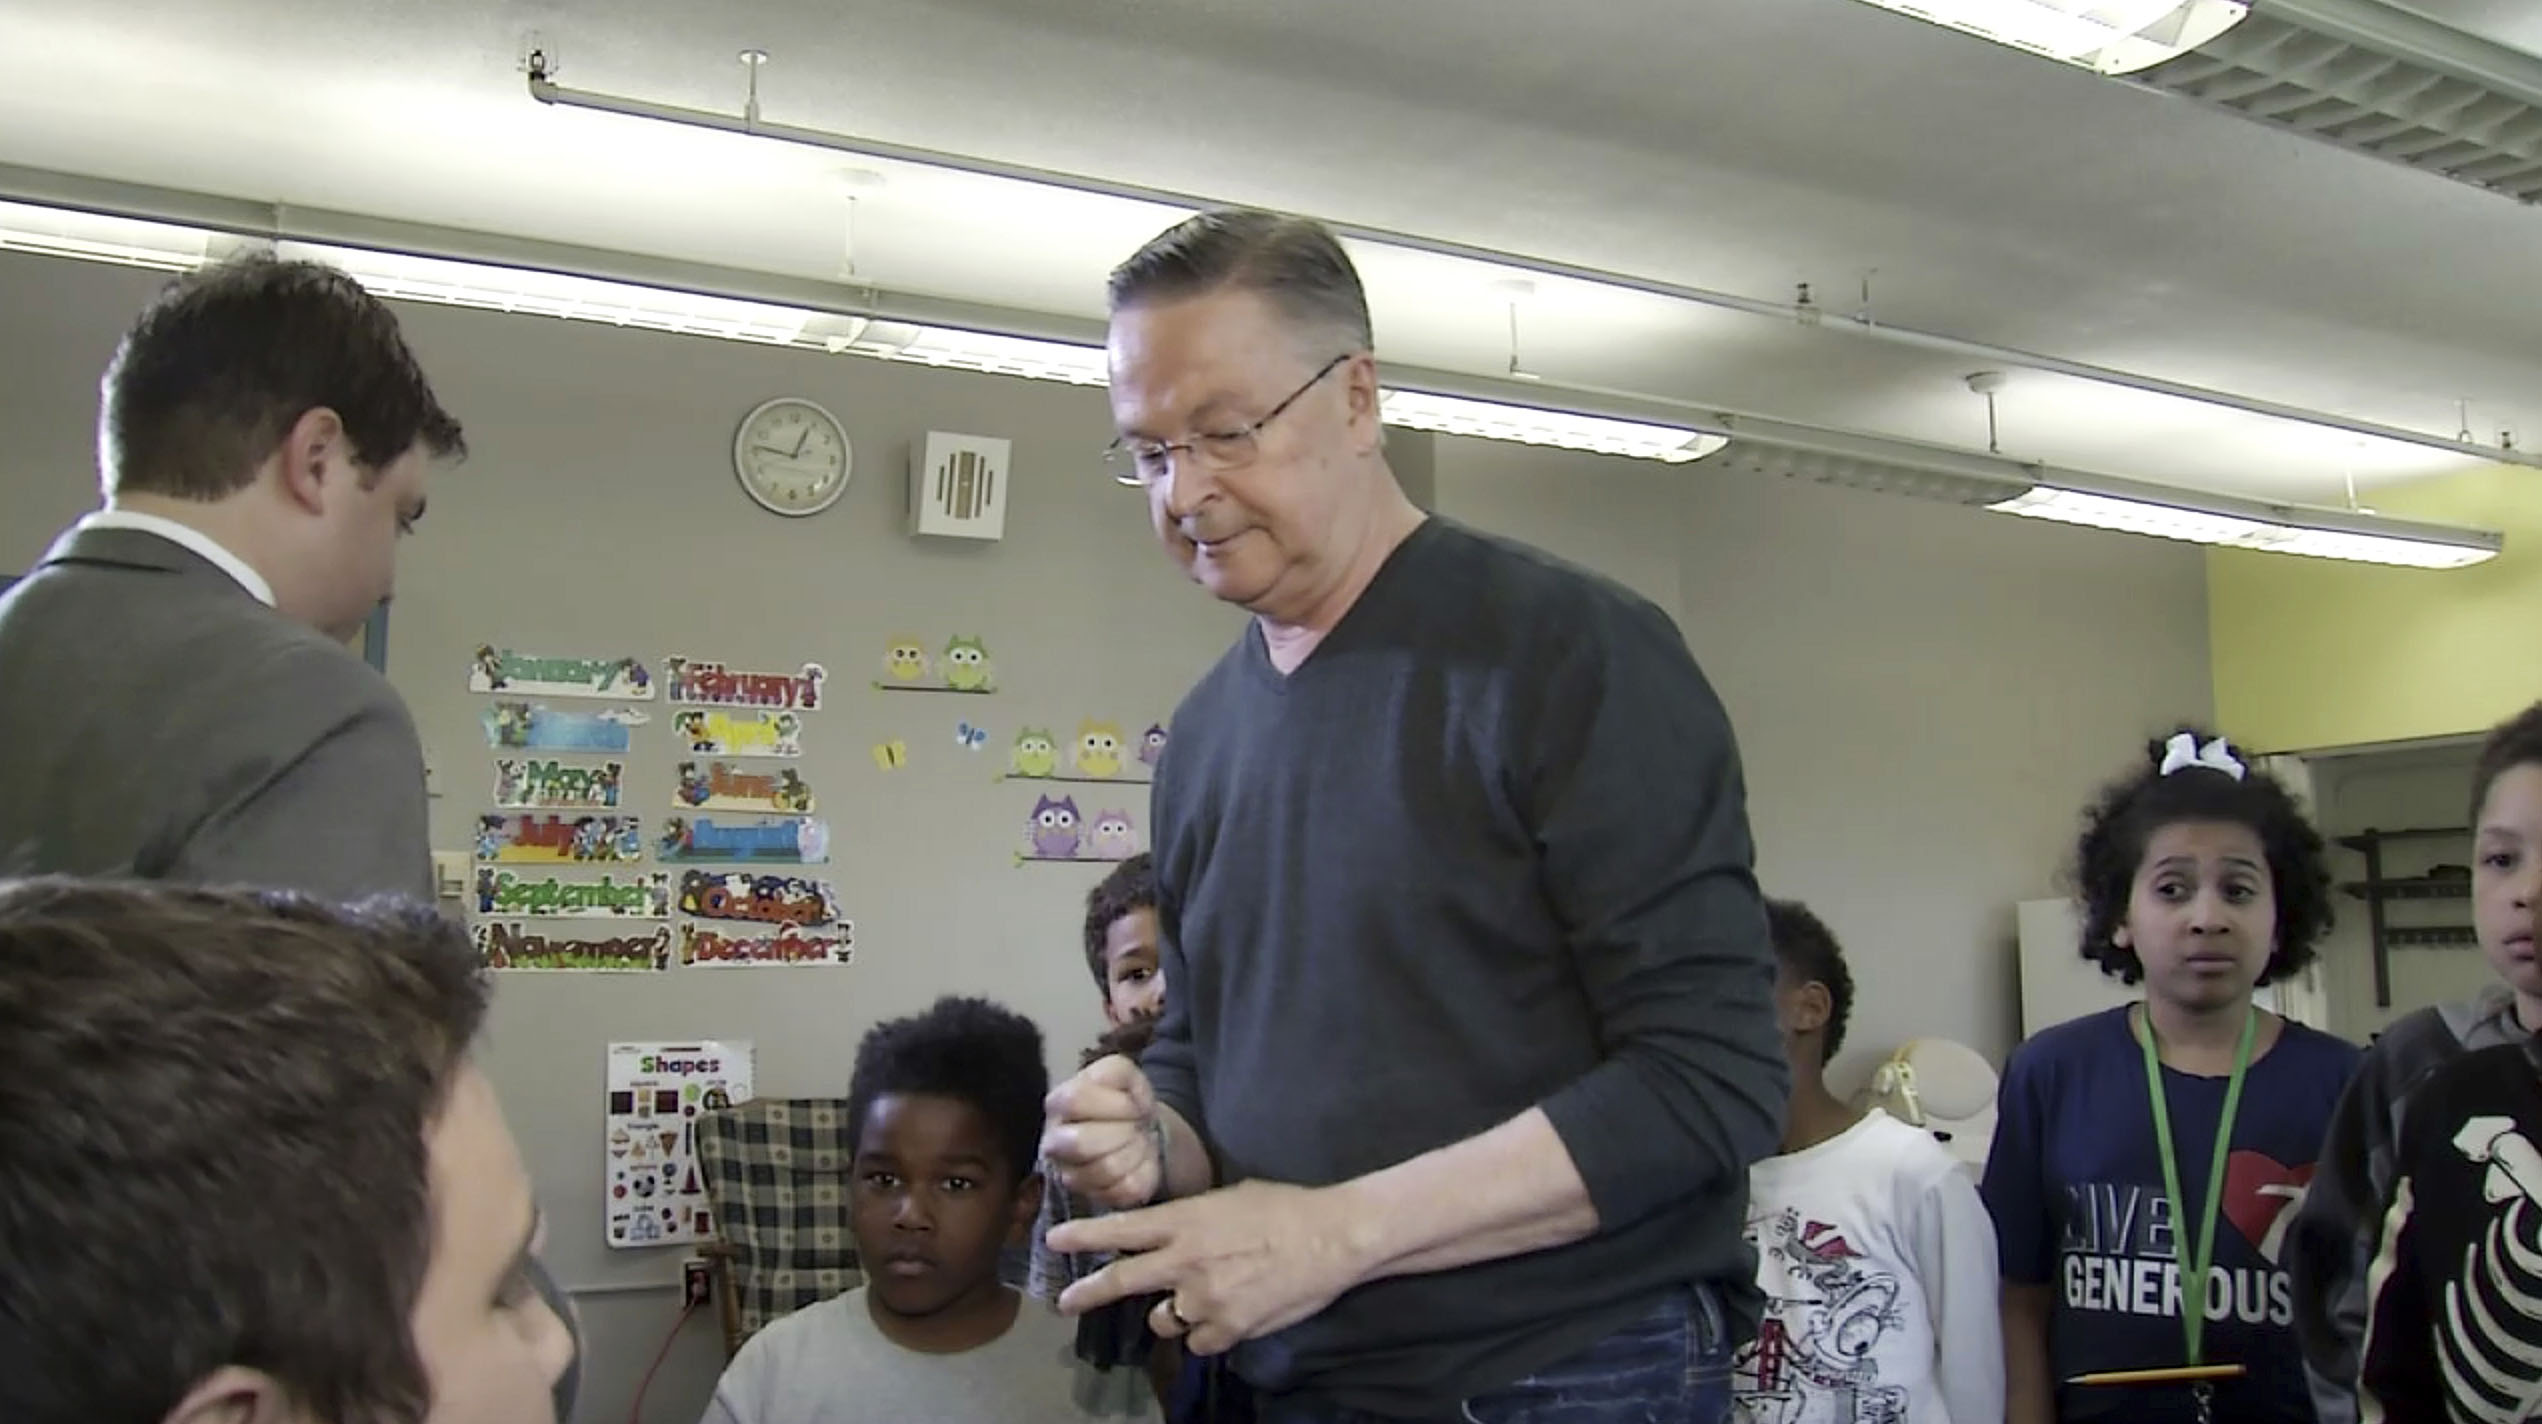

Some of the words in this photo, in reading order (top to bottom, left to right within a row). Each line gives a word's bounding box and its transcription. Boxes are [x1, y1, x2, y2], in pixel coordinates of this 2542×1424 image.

[683, 662, 804, 706] February
[527, 760, 605, 798] May
[495, 872, 652, 914] September
[489, 922, 655, 964] November
[695, 925, 836, 961] December
[640, 1055, 721, 1077] Shapes
